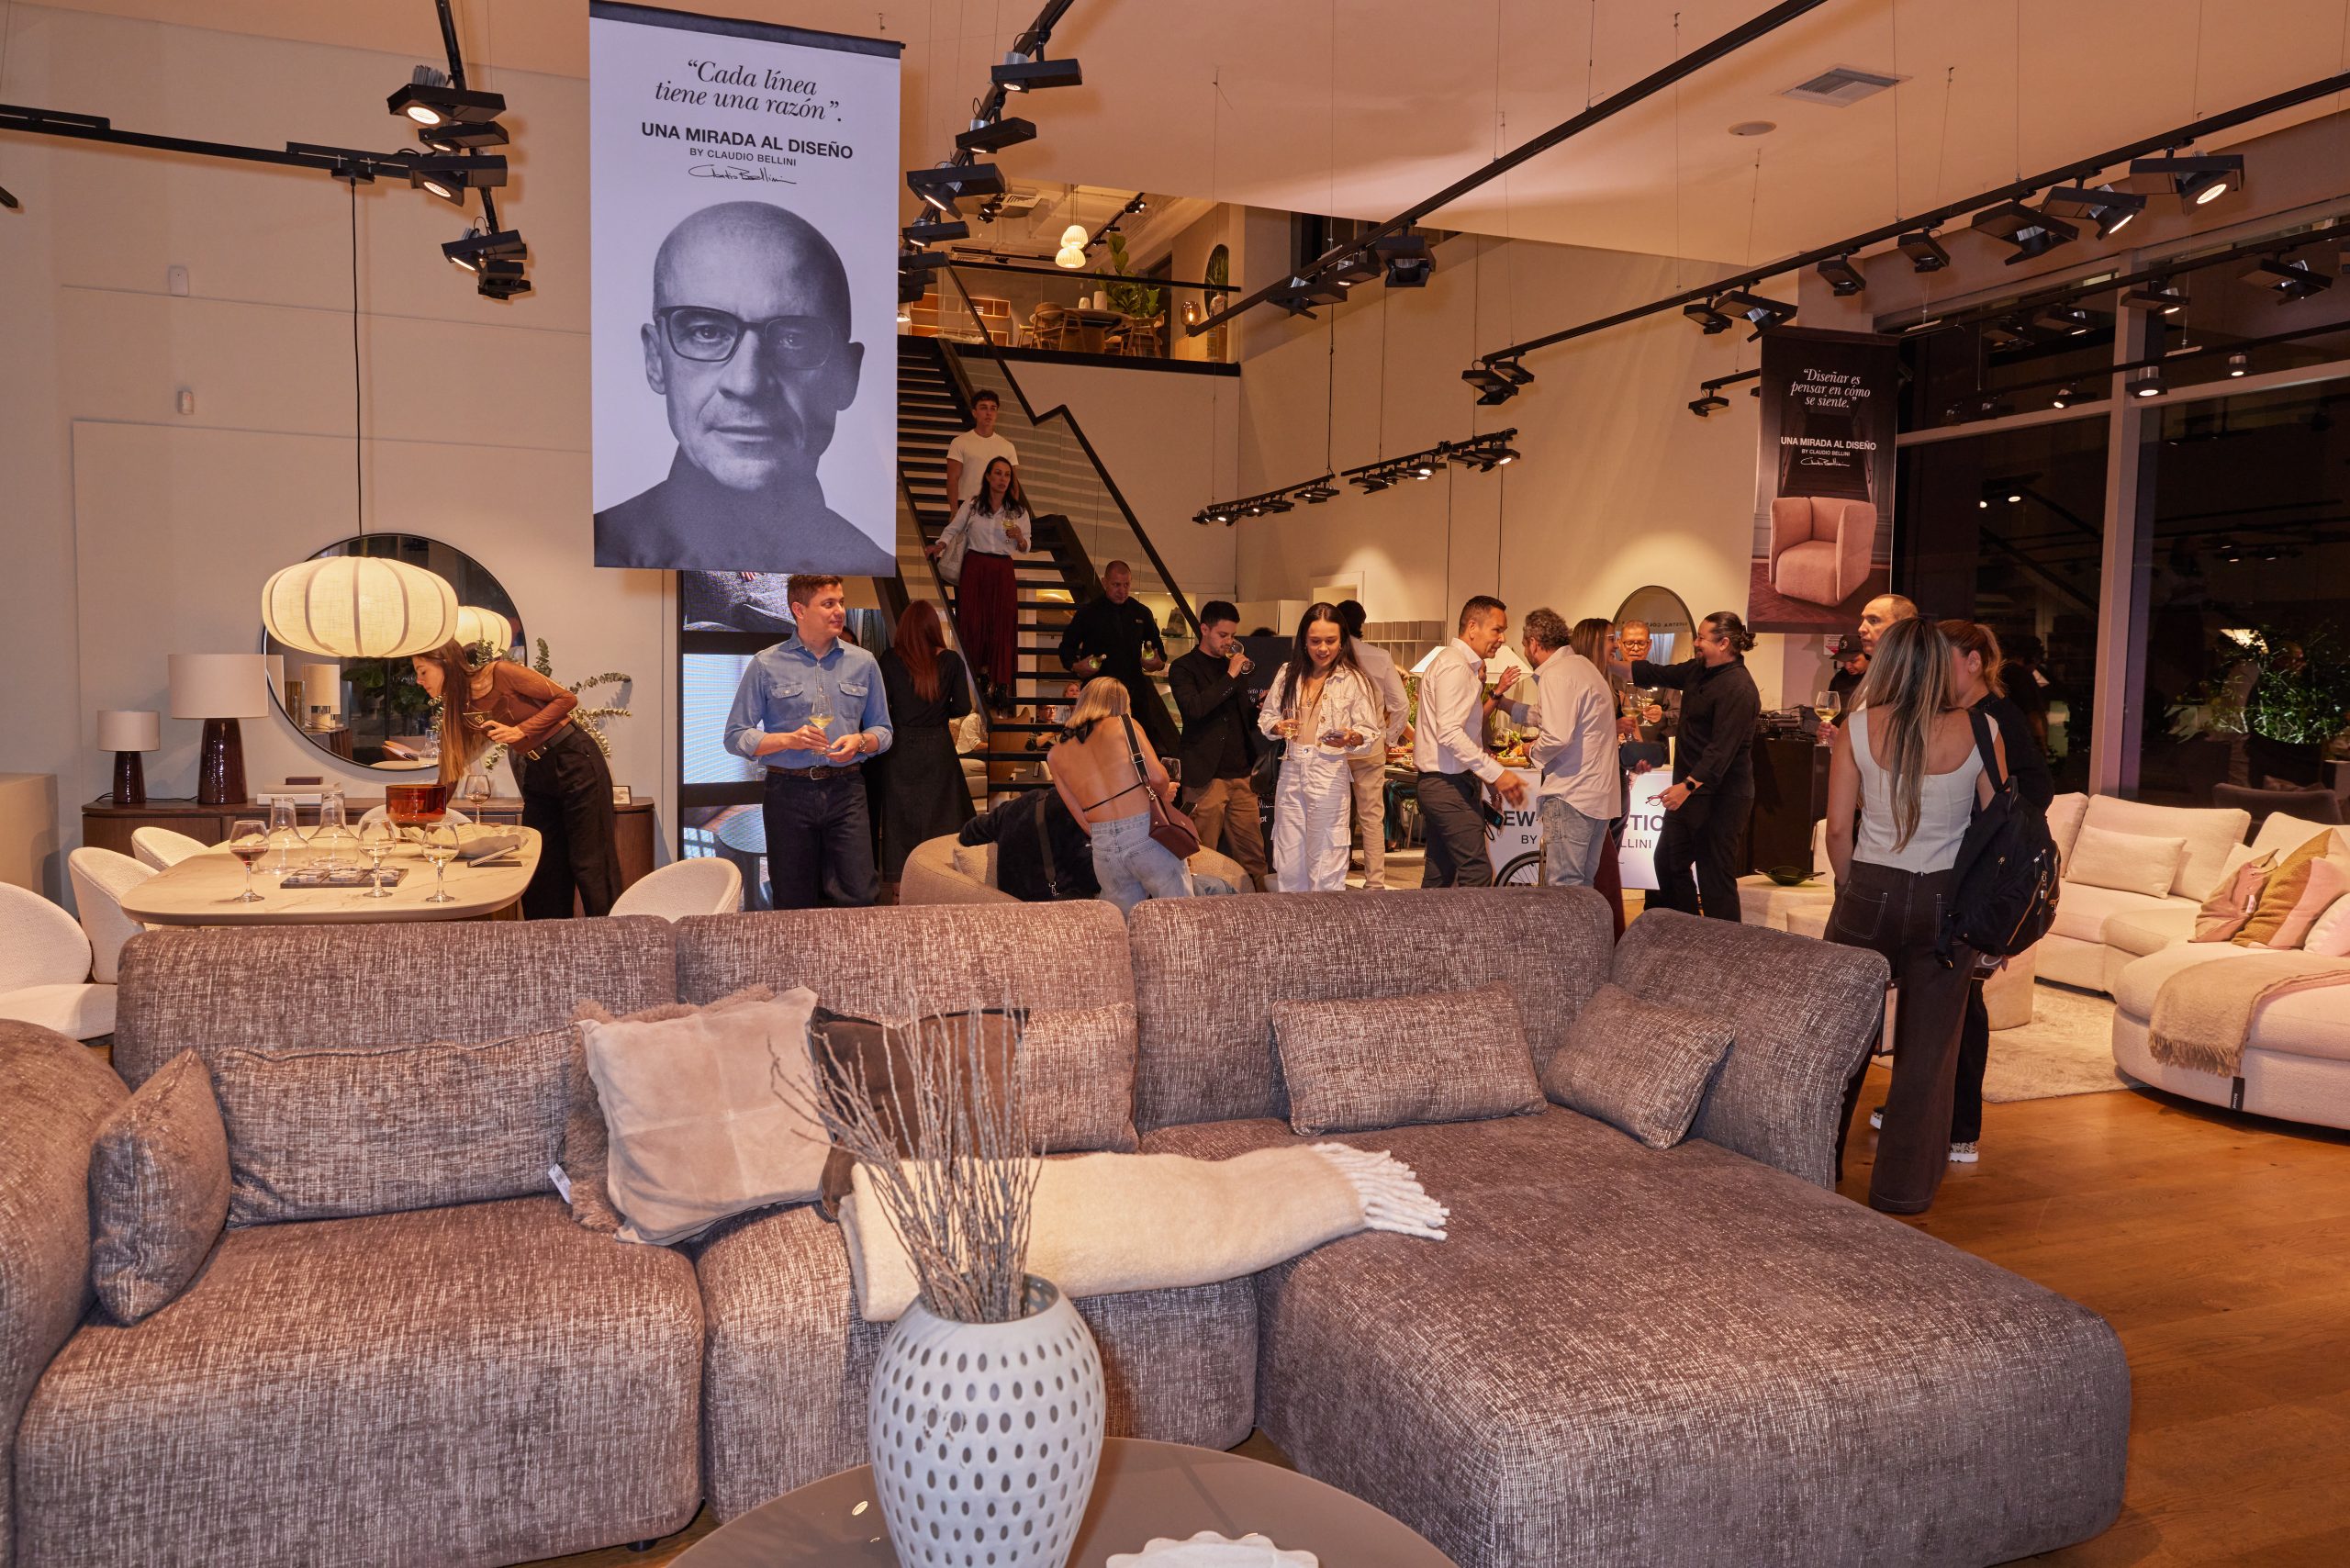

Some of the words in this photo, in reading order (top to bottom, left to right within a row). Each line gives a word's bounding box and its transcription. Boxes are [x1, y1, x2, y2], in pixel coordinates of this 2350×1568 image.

[764, 69, 817, 96] línea
[655, 80, 708, 106] tiene
[713, 92, 759, 111] una
[642, 121, 680, 140] UNA
[686, 127, 756, 148] MIRADA
[761, 135, 783, 151] AL
[788, 139, 854, 160] DISEÑO
[689, 147, 704, 157] BY
[707, 150, 754, 162] CLAUDIO
[757, 153, 797, 167] BELLINI
[1851, 375, 1861, 386] es
[1790, 381, 1827, 397] pensar
[1829, 386, 1841, 396] en
[1844, 385, 1871, 398] cómo
[1805, 397, 1815, 406] se
[1780, 436, 1798, 446] UNA
[1799, 437, 1832, 448] MIRADA
[1833, 439, 1844, 449] AL
[1846, 440, 1877, 451] DISEÑO
[1502, 810, 1536, 827] EW
[1521, 834, 1538, 845] BY
